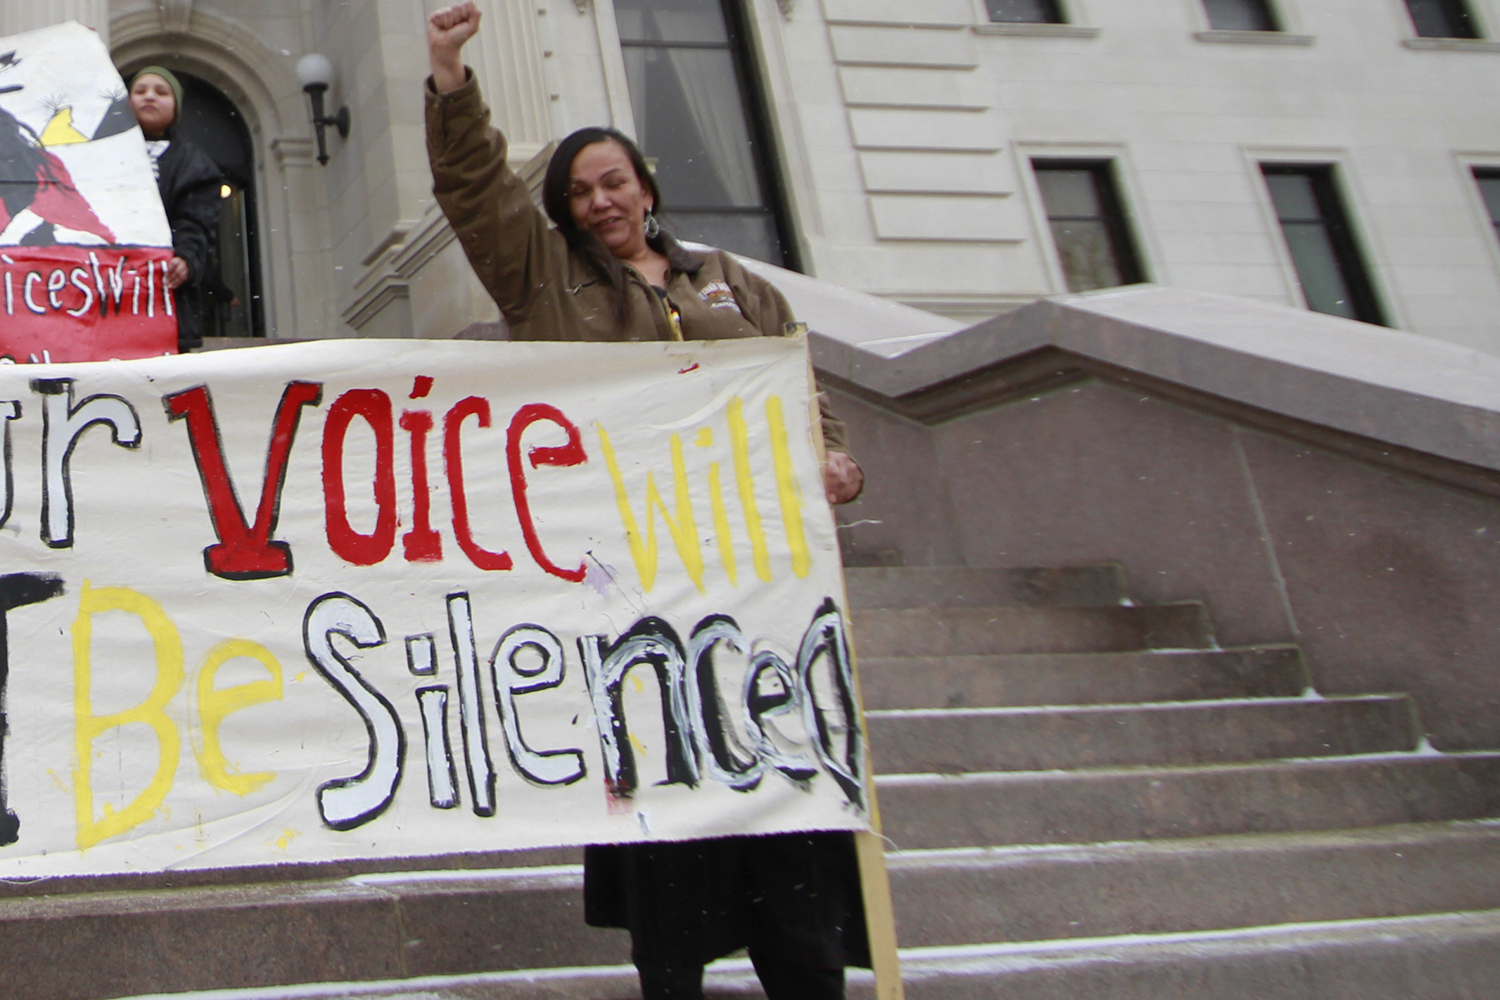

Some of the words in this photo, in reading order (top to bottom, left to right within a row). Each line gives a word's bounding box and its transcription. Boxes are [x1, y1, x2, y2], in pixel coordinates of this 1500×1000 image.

[162, 374, 589, 583] Voice
[69, 576, 285, 858] Be
[302, 590, 866, 831] Silenced
